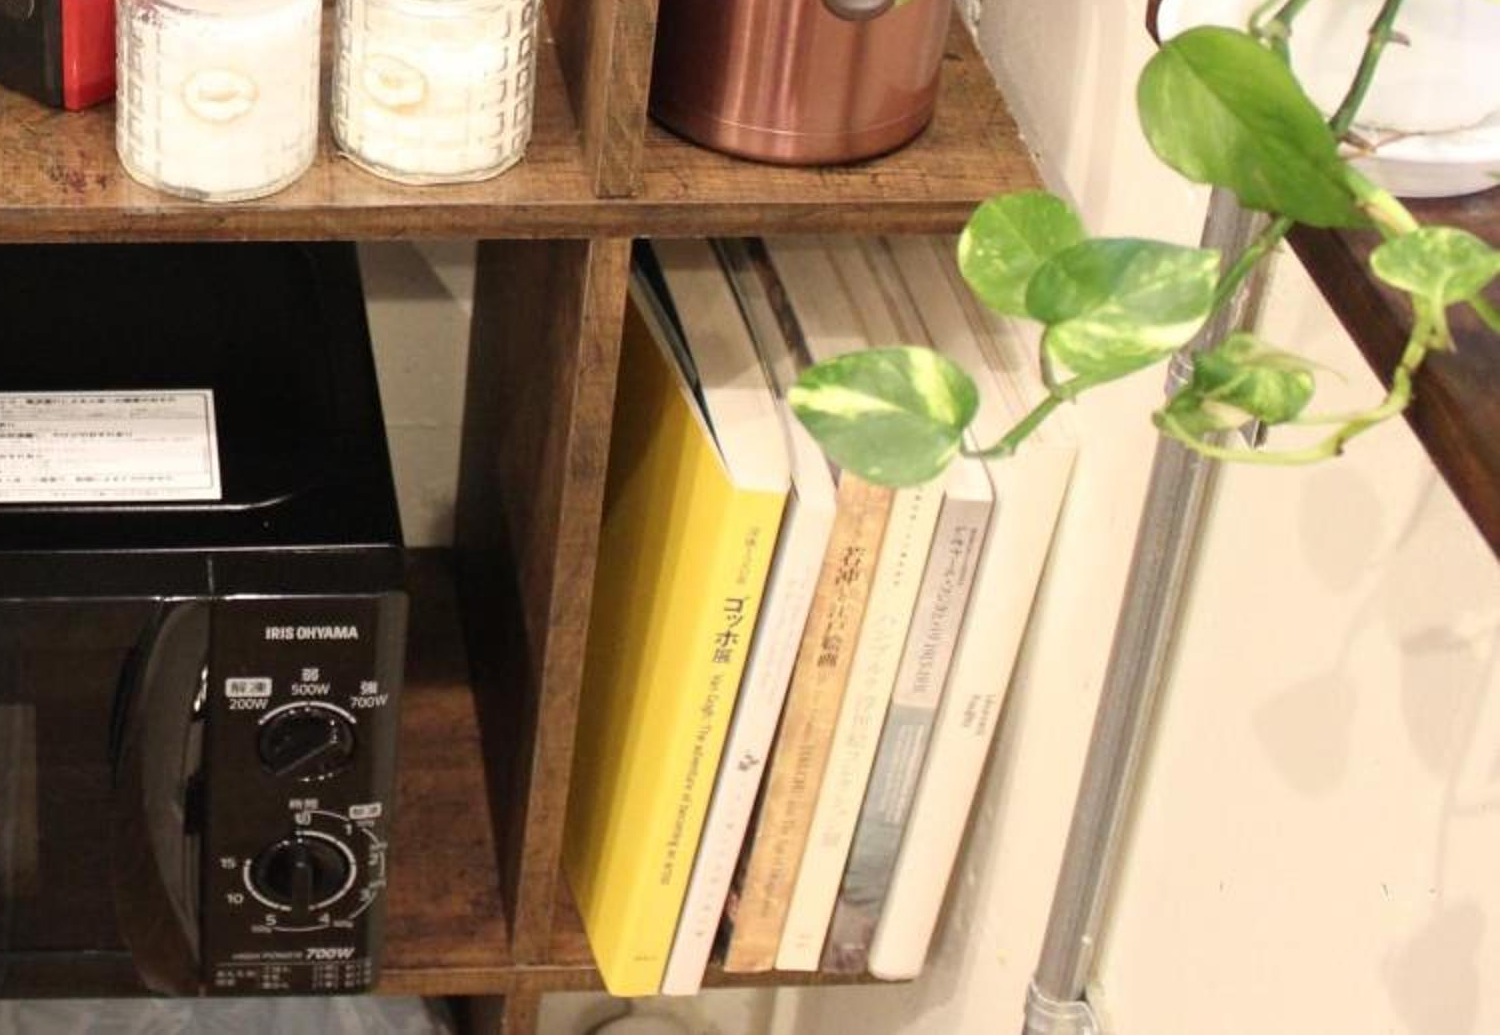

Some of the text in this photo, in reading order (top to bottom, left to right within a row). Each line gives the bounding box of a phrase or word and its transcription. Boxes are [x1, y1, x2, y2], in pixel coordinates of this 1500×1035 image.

[265, 626, 359, 640] IRIS OHYAMA
[291, 684, 331, 696] 500W
[229, 699, 269, 710] 200W
[351, 694, 389, 708] 700W
[345, 824, 353, 835] 1
[220, 858, 237, 869] 15
[227, 894, 244, 904] 10
[265, 914, 277, 926] 5
[306, 947, 355, 960] 700W
